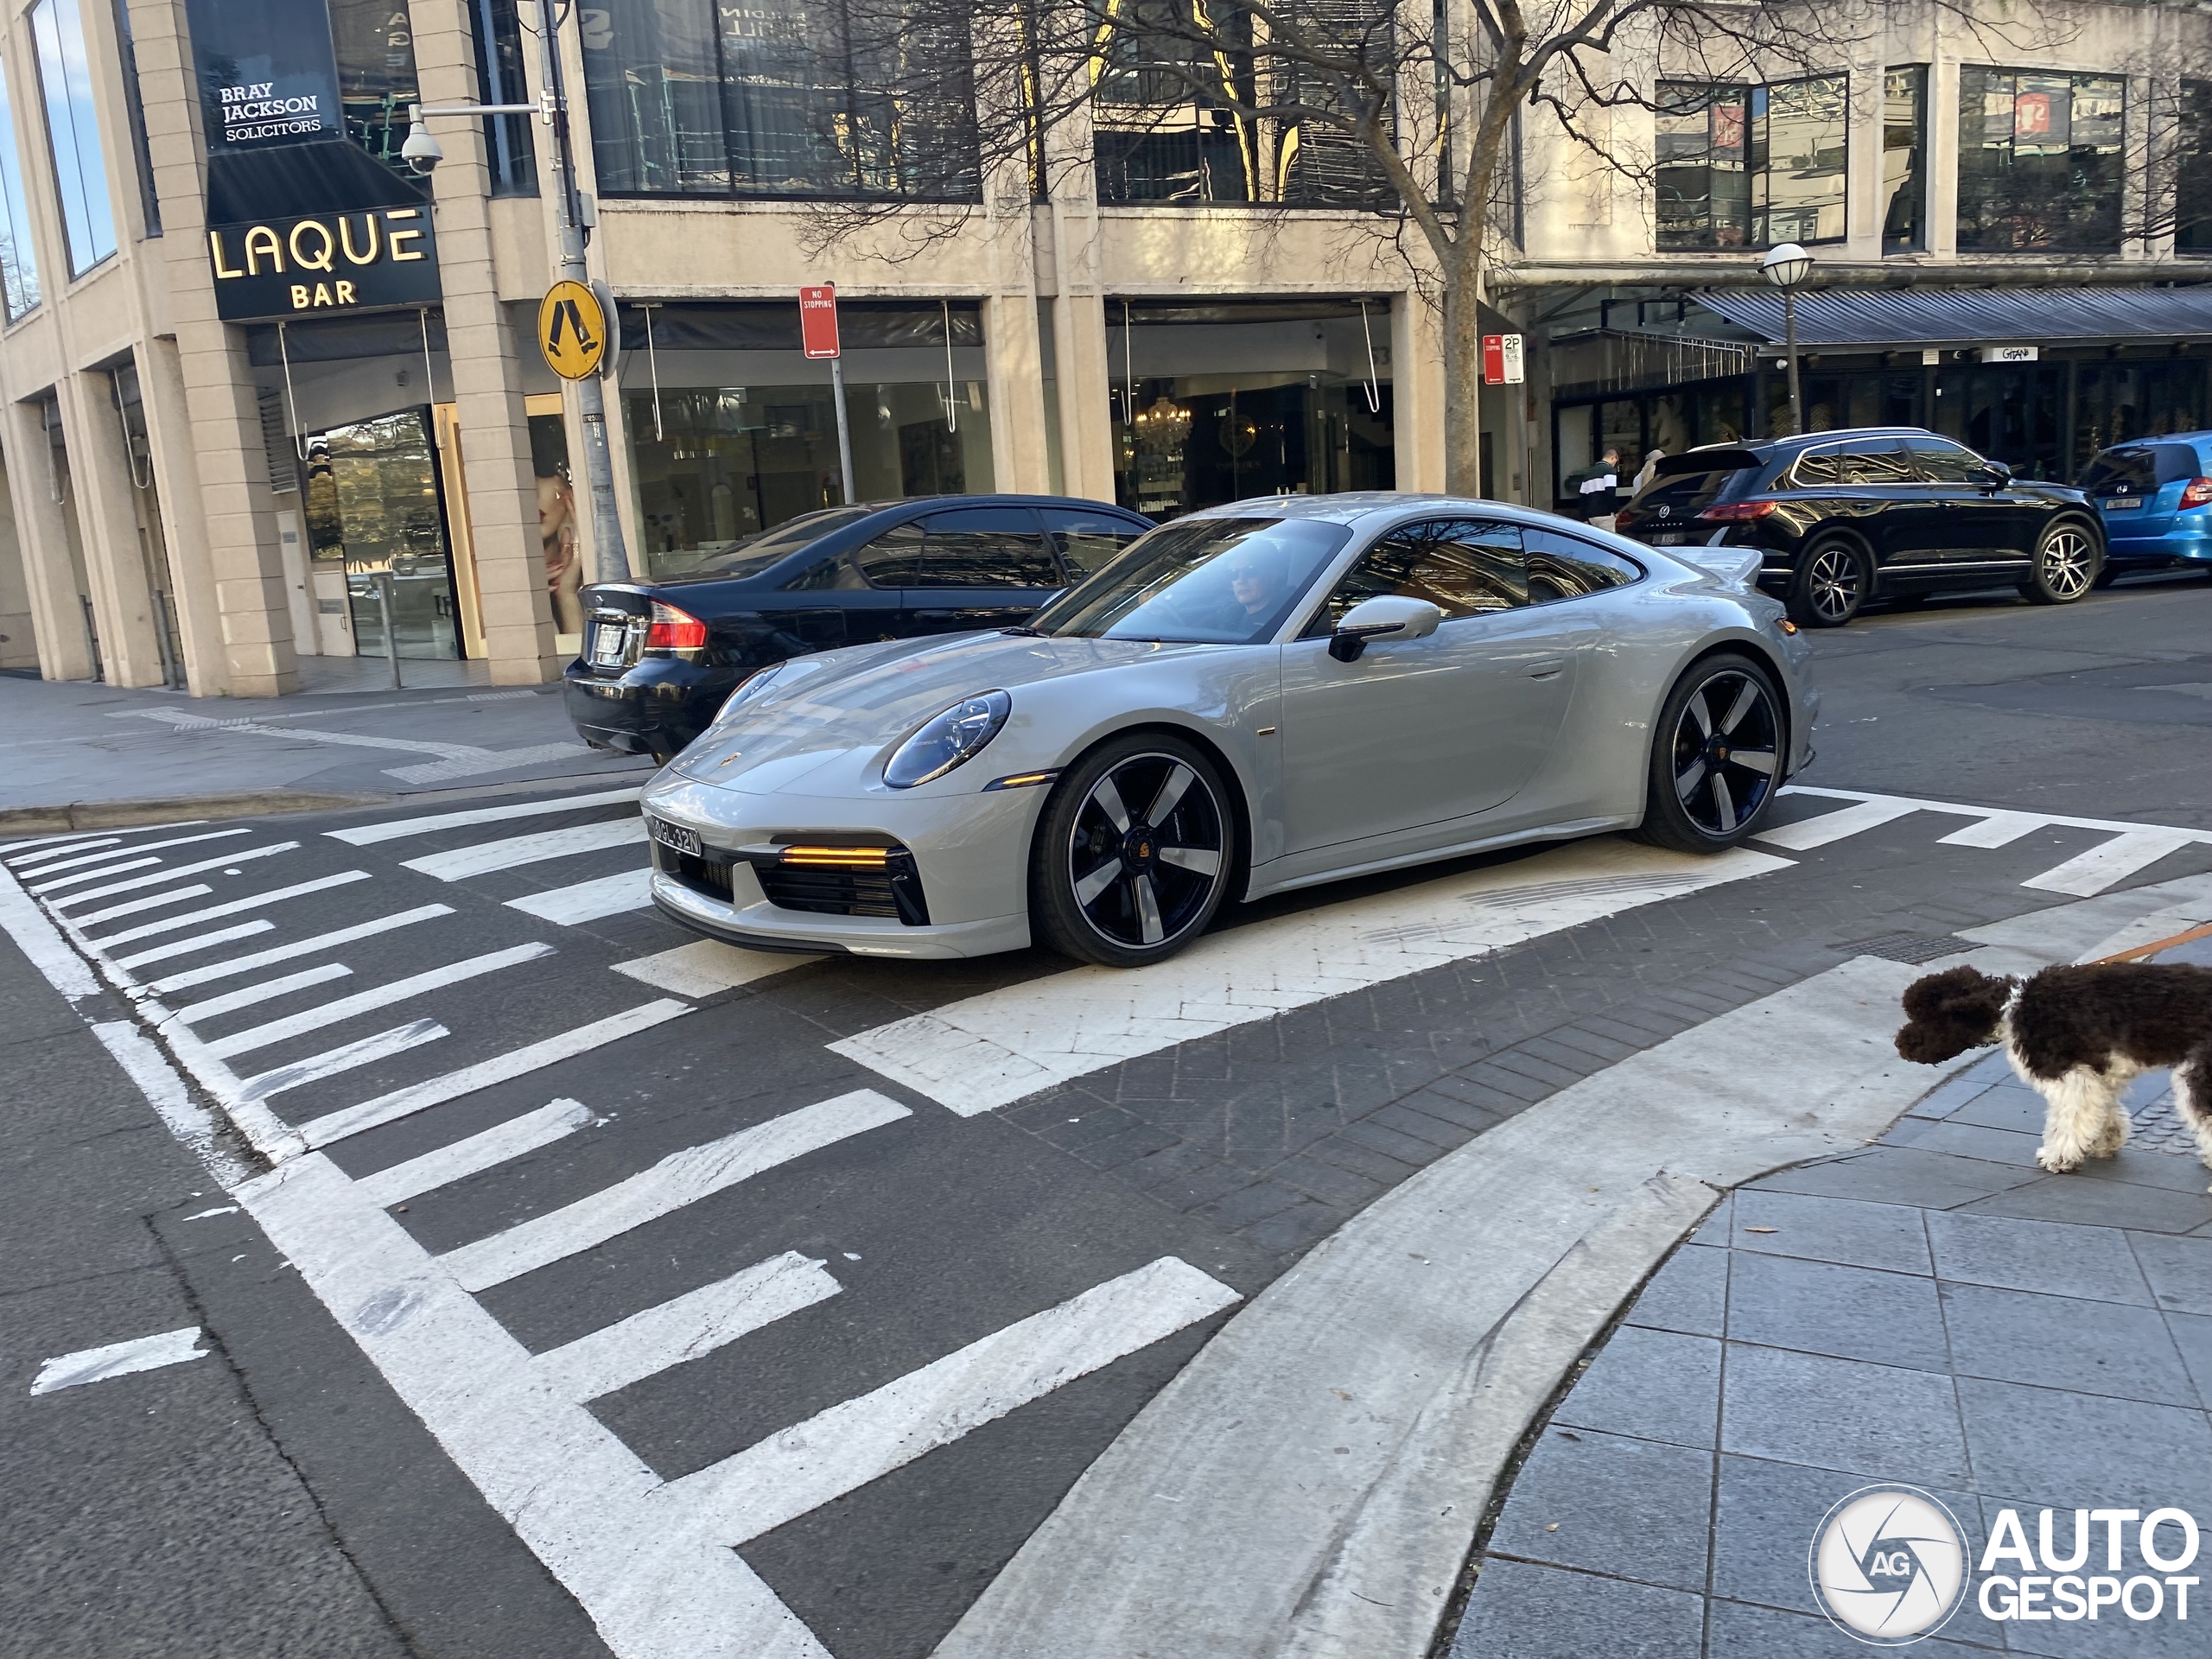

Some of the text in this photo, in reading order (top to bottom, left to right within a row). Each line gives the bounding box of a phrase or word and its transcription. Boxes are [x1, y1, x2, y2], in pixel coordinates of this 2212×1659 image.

[219, 82, 274, 103] BRAY
[222, 95, 318, 124] JACKSON
[226, 119, 321, 142] SOLICITORS
[210, 210, 424, 279] LAQUE
[290, 280, 357, 309] BAR
[804, 300, 832, 309] STOPPING
[811, 290, 823, 299] NO
[1504, 338, 1520, 350] 2P
